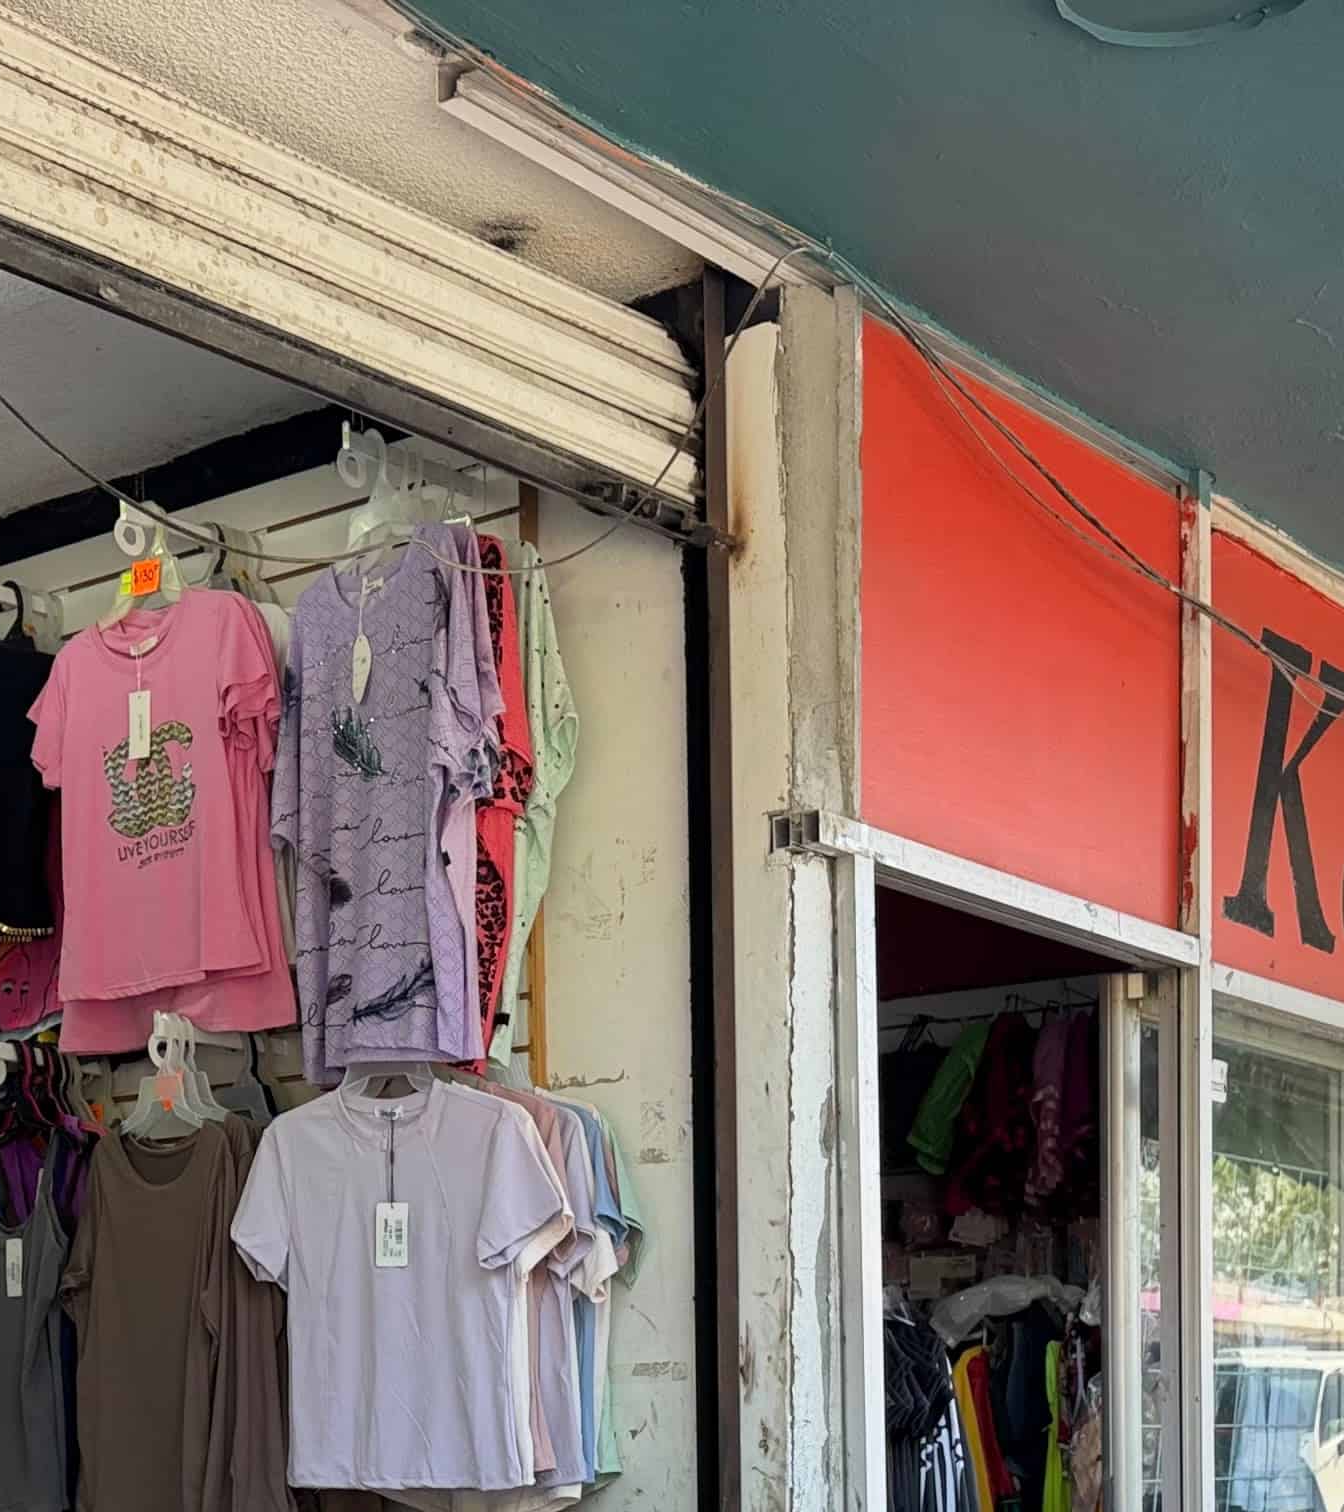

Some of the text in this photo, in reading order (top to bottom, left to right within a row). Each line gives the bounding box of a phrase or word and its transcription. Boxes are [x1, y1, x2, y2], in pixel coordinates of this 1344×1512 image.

[364, 818, 424, 850] love
[362, 868, 425, 899] love
[359, 923, 430, 951] love
